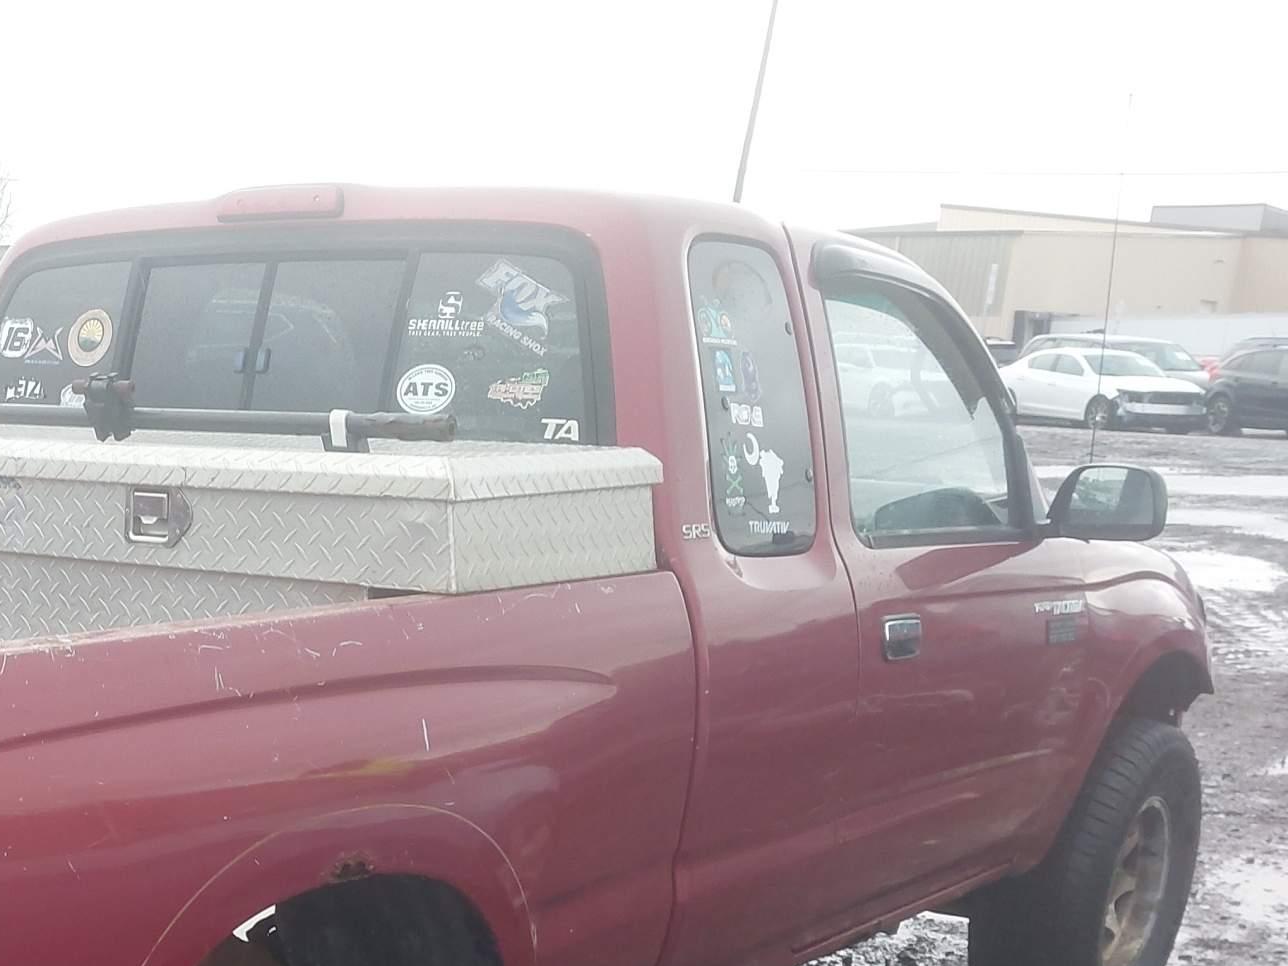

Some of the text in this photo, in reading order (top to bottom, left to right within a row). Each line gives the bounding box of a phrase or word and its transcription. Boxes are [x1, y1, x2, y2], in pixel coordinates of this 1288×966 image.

[480, 261, 569, 313] FOX
[486, 314, 548, 357] RACING SHOX
[403, 382, 449, 397] ATS
[541, 418, 580, 442] TA
[748, 520, 790, 535] TRUVATIV
